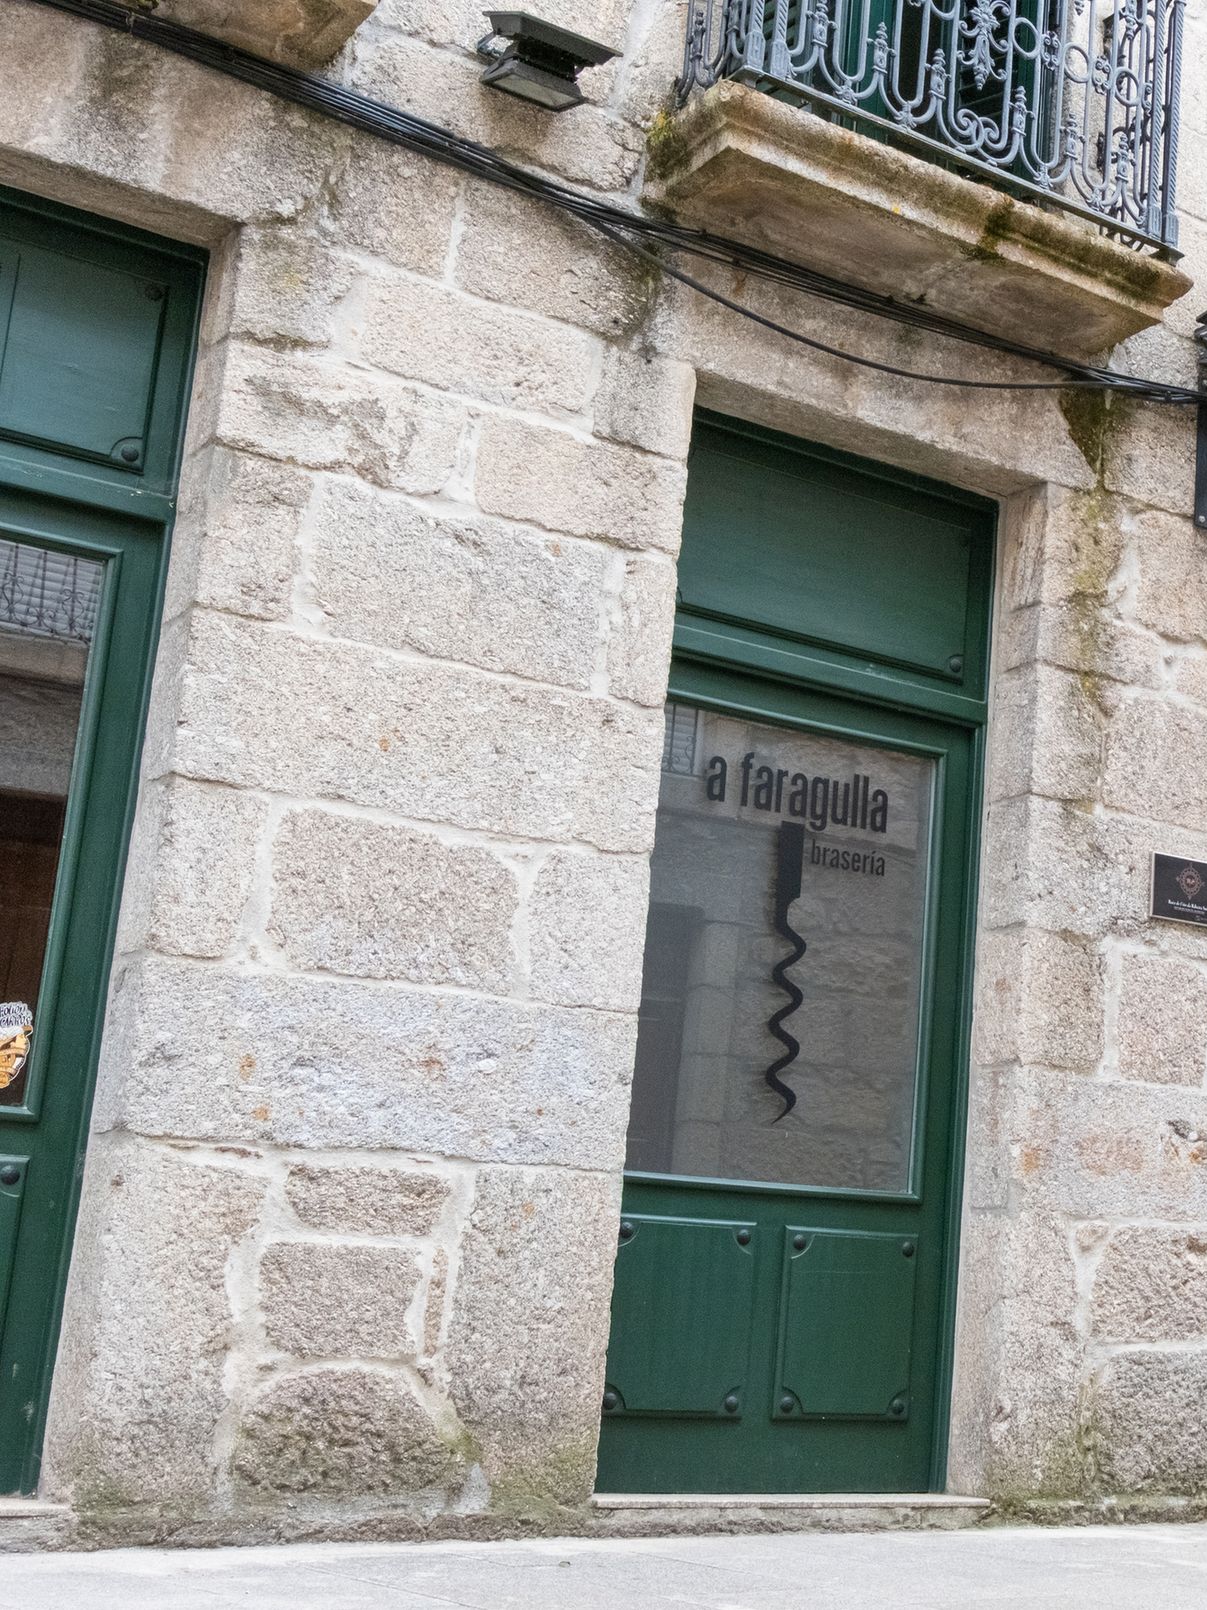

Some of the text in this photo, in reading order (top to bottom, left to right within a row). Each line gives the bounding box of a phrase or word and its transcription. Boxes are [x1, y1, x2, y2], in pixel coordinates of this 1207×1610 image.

[706, 752, 889, 833] a faragulla
[810, 839, 886, 877] brasería
